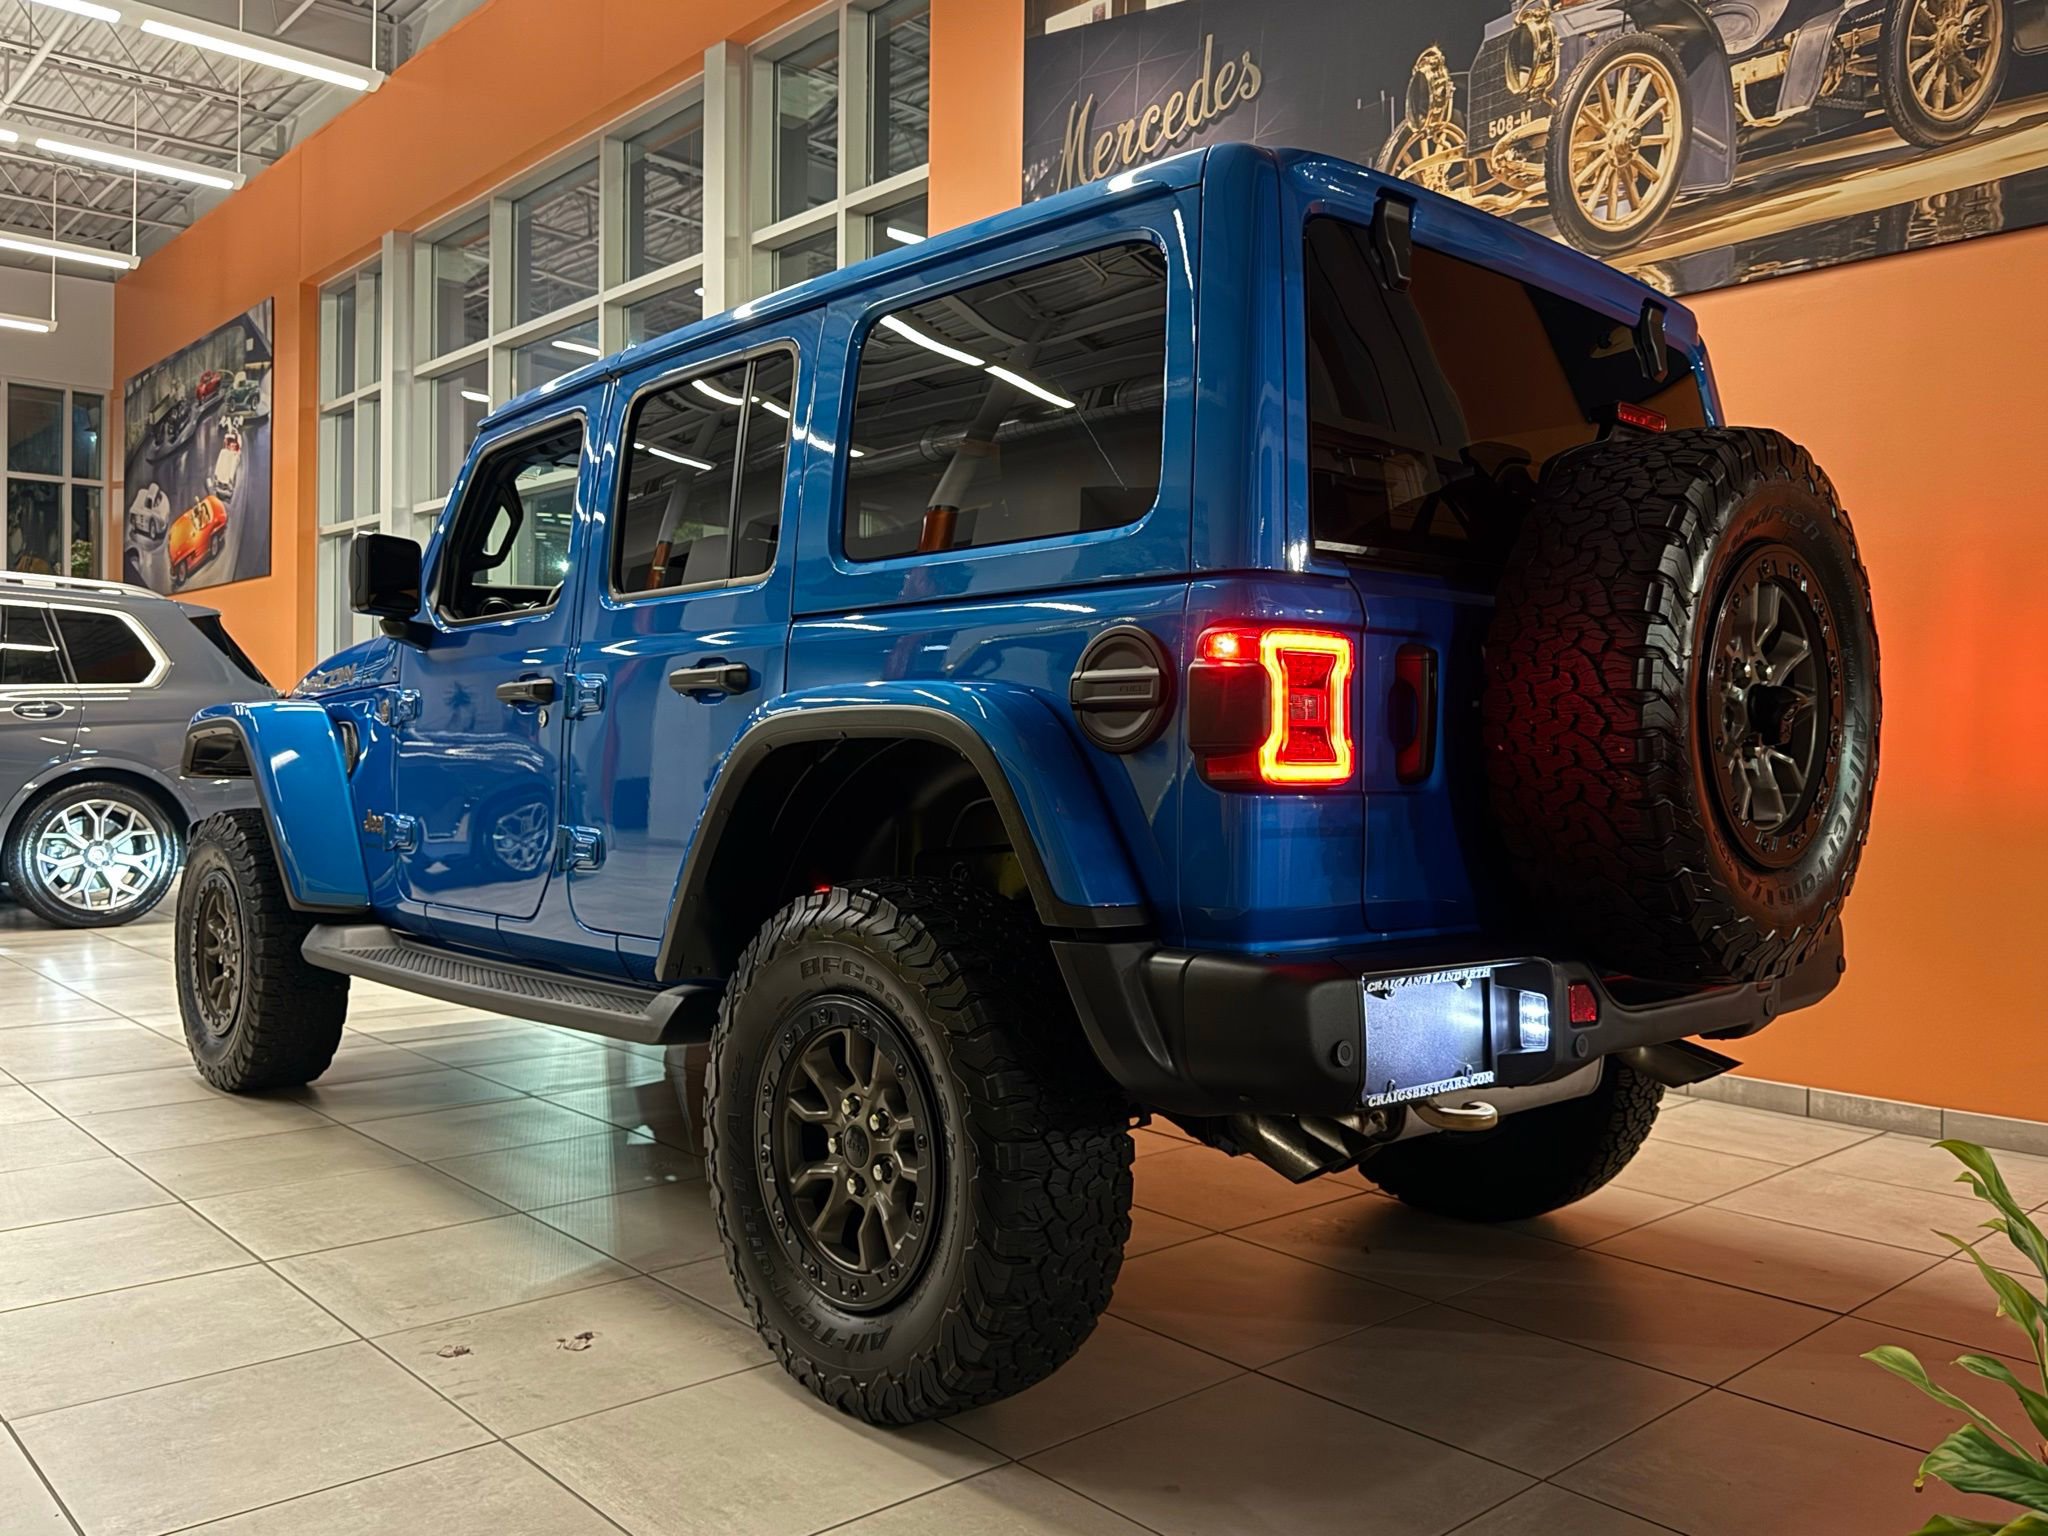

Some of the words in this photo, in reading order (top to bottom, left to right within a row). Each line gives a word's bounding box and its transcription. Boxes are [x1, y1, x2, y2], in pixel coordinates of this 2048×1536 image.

[1056, 33, 1262, 195] Mercedes
[1487, 109, 1532, 138] 508-M
[1367, 1071, 1495, 1107] CRAIGSBESTCARS.COM
